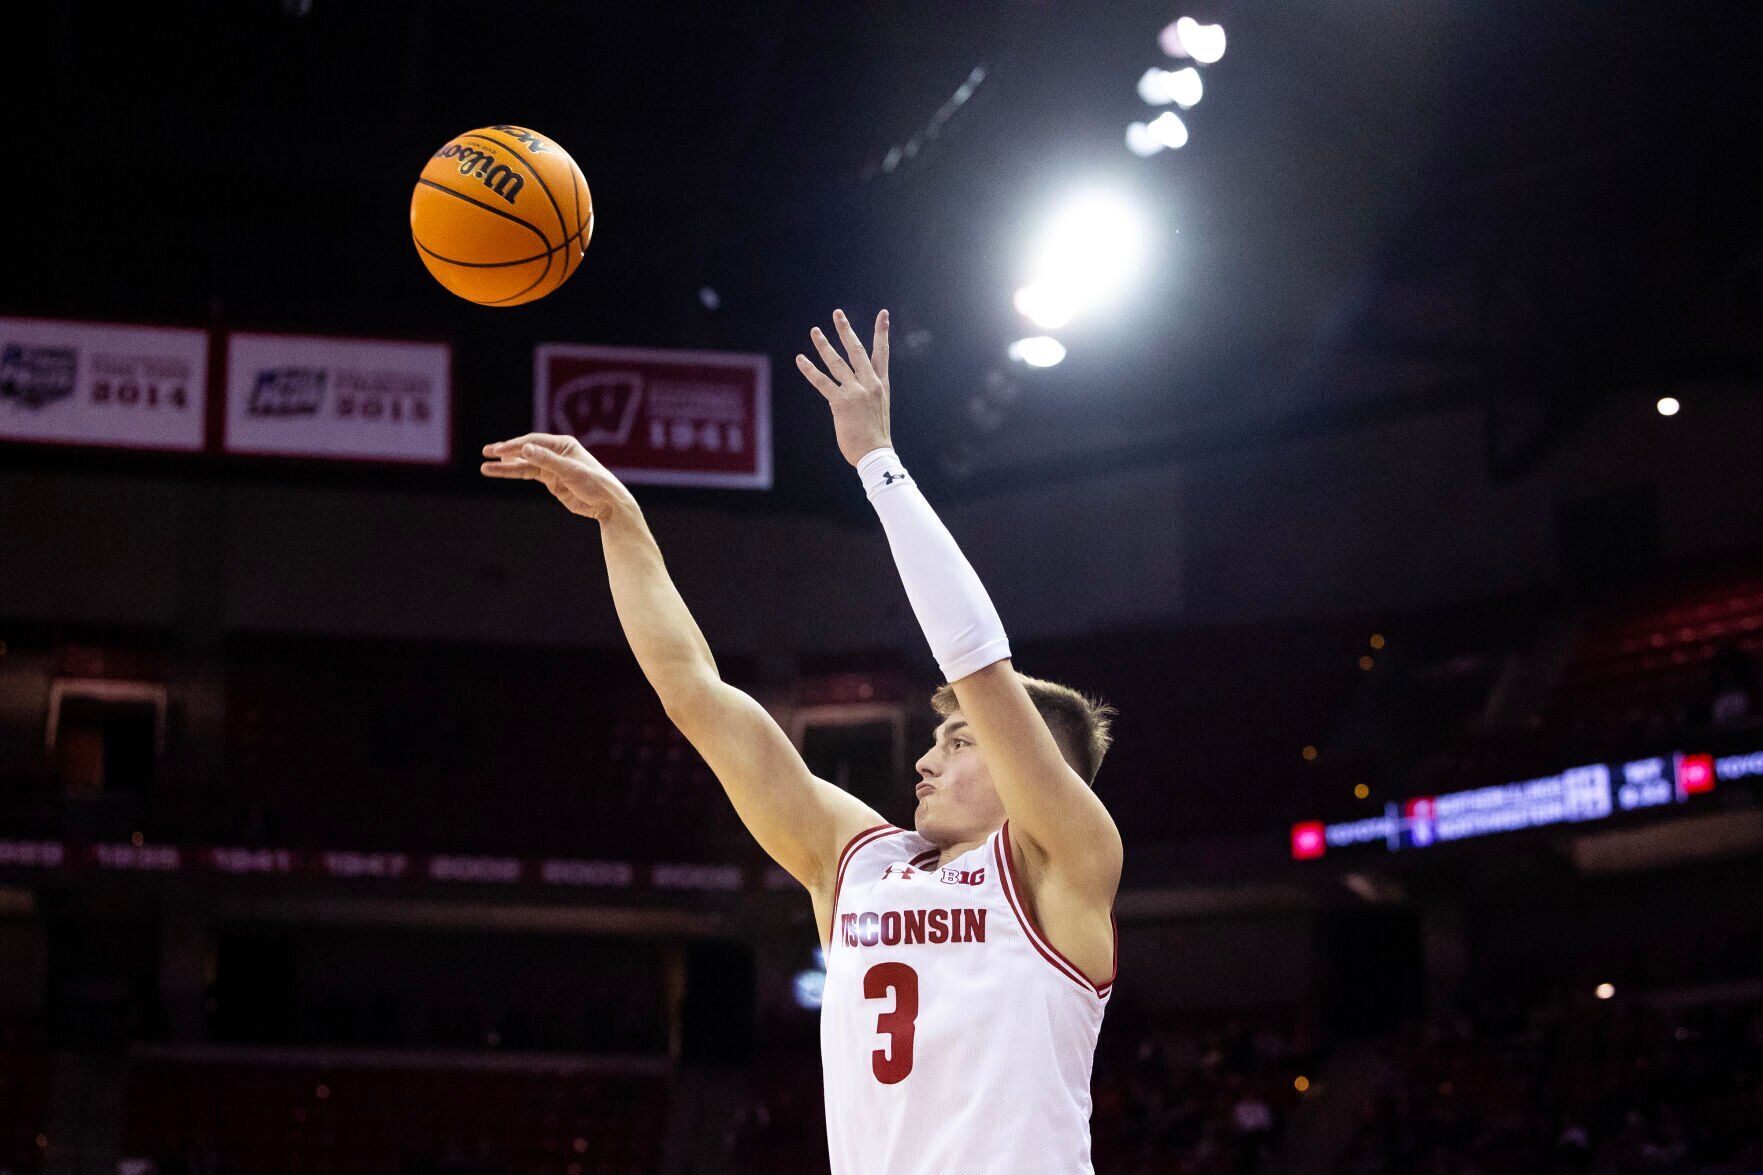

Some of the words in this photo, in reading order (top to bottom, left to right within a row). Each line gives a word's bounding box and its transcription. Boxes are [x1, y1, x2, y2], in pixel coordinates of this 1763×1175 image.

[91, 378, 188, 410] 2014
[651, 418, 744, 452] 1941
[863, 961, 918, 1085] 3
